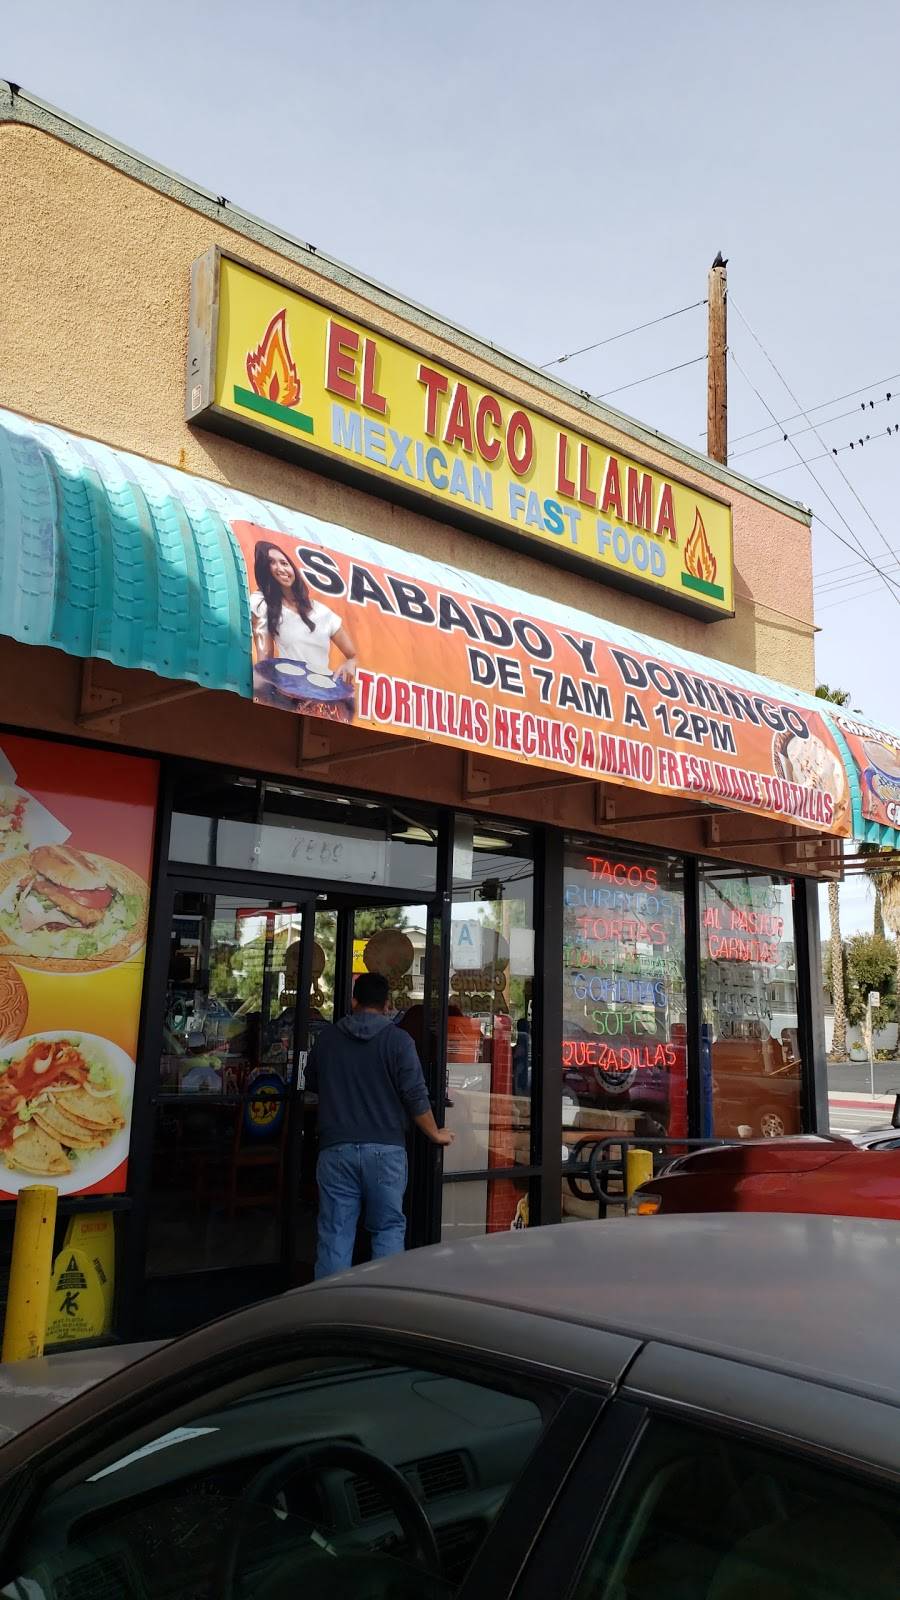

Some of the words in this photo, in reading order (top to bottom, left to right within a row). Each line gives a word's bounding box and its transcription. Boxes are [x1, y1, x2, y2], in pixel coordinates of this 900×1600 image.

[325, 318, 387, 415] EL
[416, 363, 534, 476] TACO
[555, 431, 678, 543] LLAMA
[331, 402, 494, 511] MEXICAN
[508, 480, 582, 544] FAST
[595, 516, 666, 578] FOOD
[297, 546, 554, 660] SABADO
[557, 631, 597, 677] Y
[608, 647, 811, 741] DOMINGO
[467, 645, 525, 696] DE
[531, 665, 614, 721] 7AM
[622, 692, 650, 731] A
[654, 701, 738, 755] 12PM
[356, 668, 490, 745] TORTILLAS
[493, 703, 578, 767] HECHAS
[580, 728, 597, 771] A
[599, 733, 655, 785] MANO
[657, 746, 715, 794] FRESH
[713, 760, 762, 806] MADE
[760, 774, 835, 827] TORTILLAS
[586, 857, 658, 891] TACOS
[457, 922, 474, 946] A
[576, 917, 668, 945] TORTAS
[708, 934, 779, 964] CARNITAS
[574, 973, 668, 1008] GORDITAS
[592, 1010, 658, 1035] SOPES
[562, 1041, 677, 1071] QUEZADILLAS
